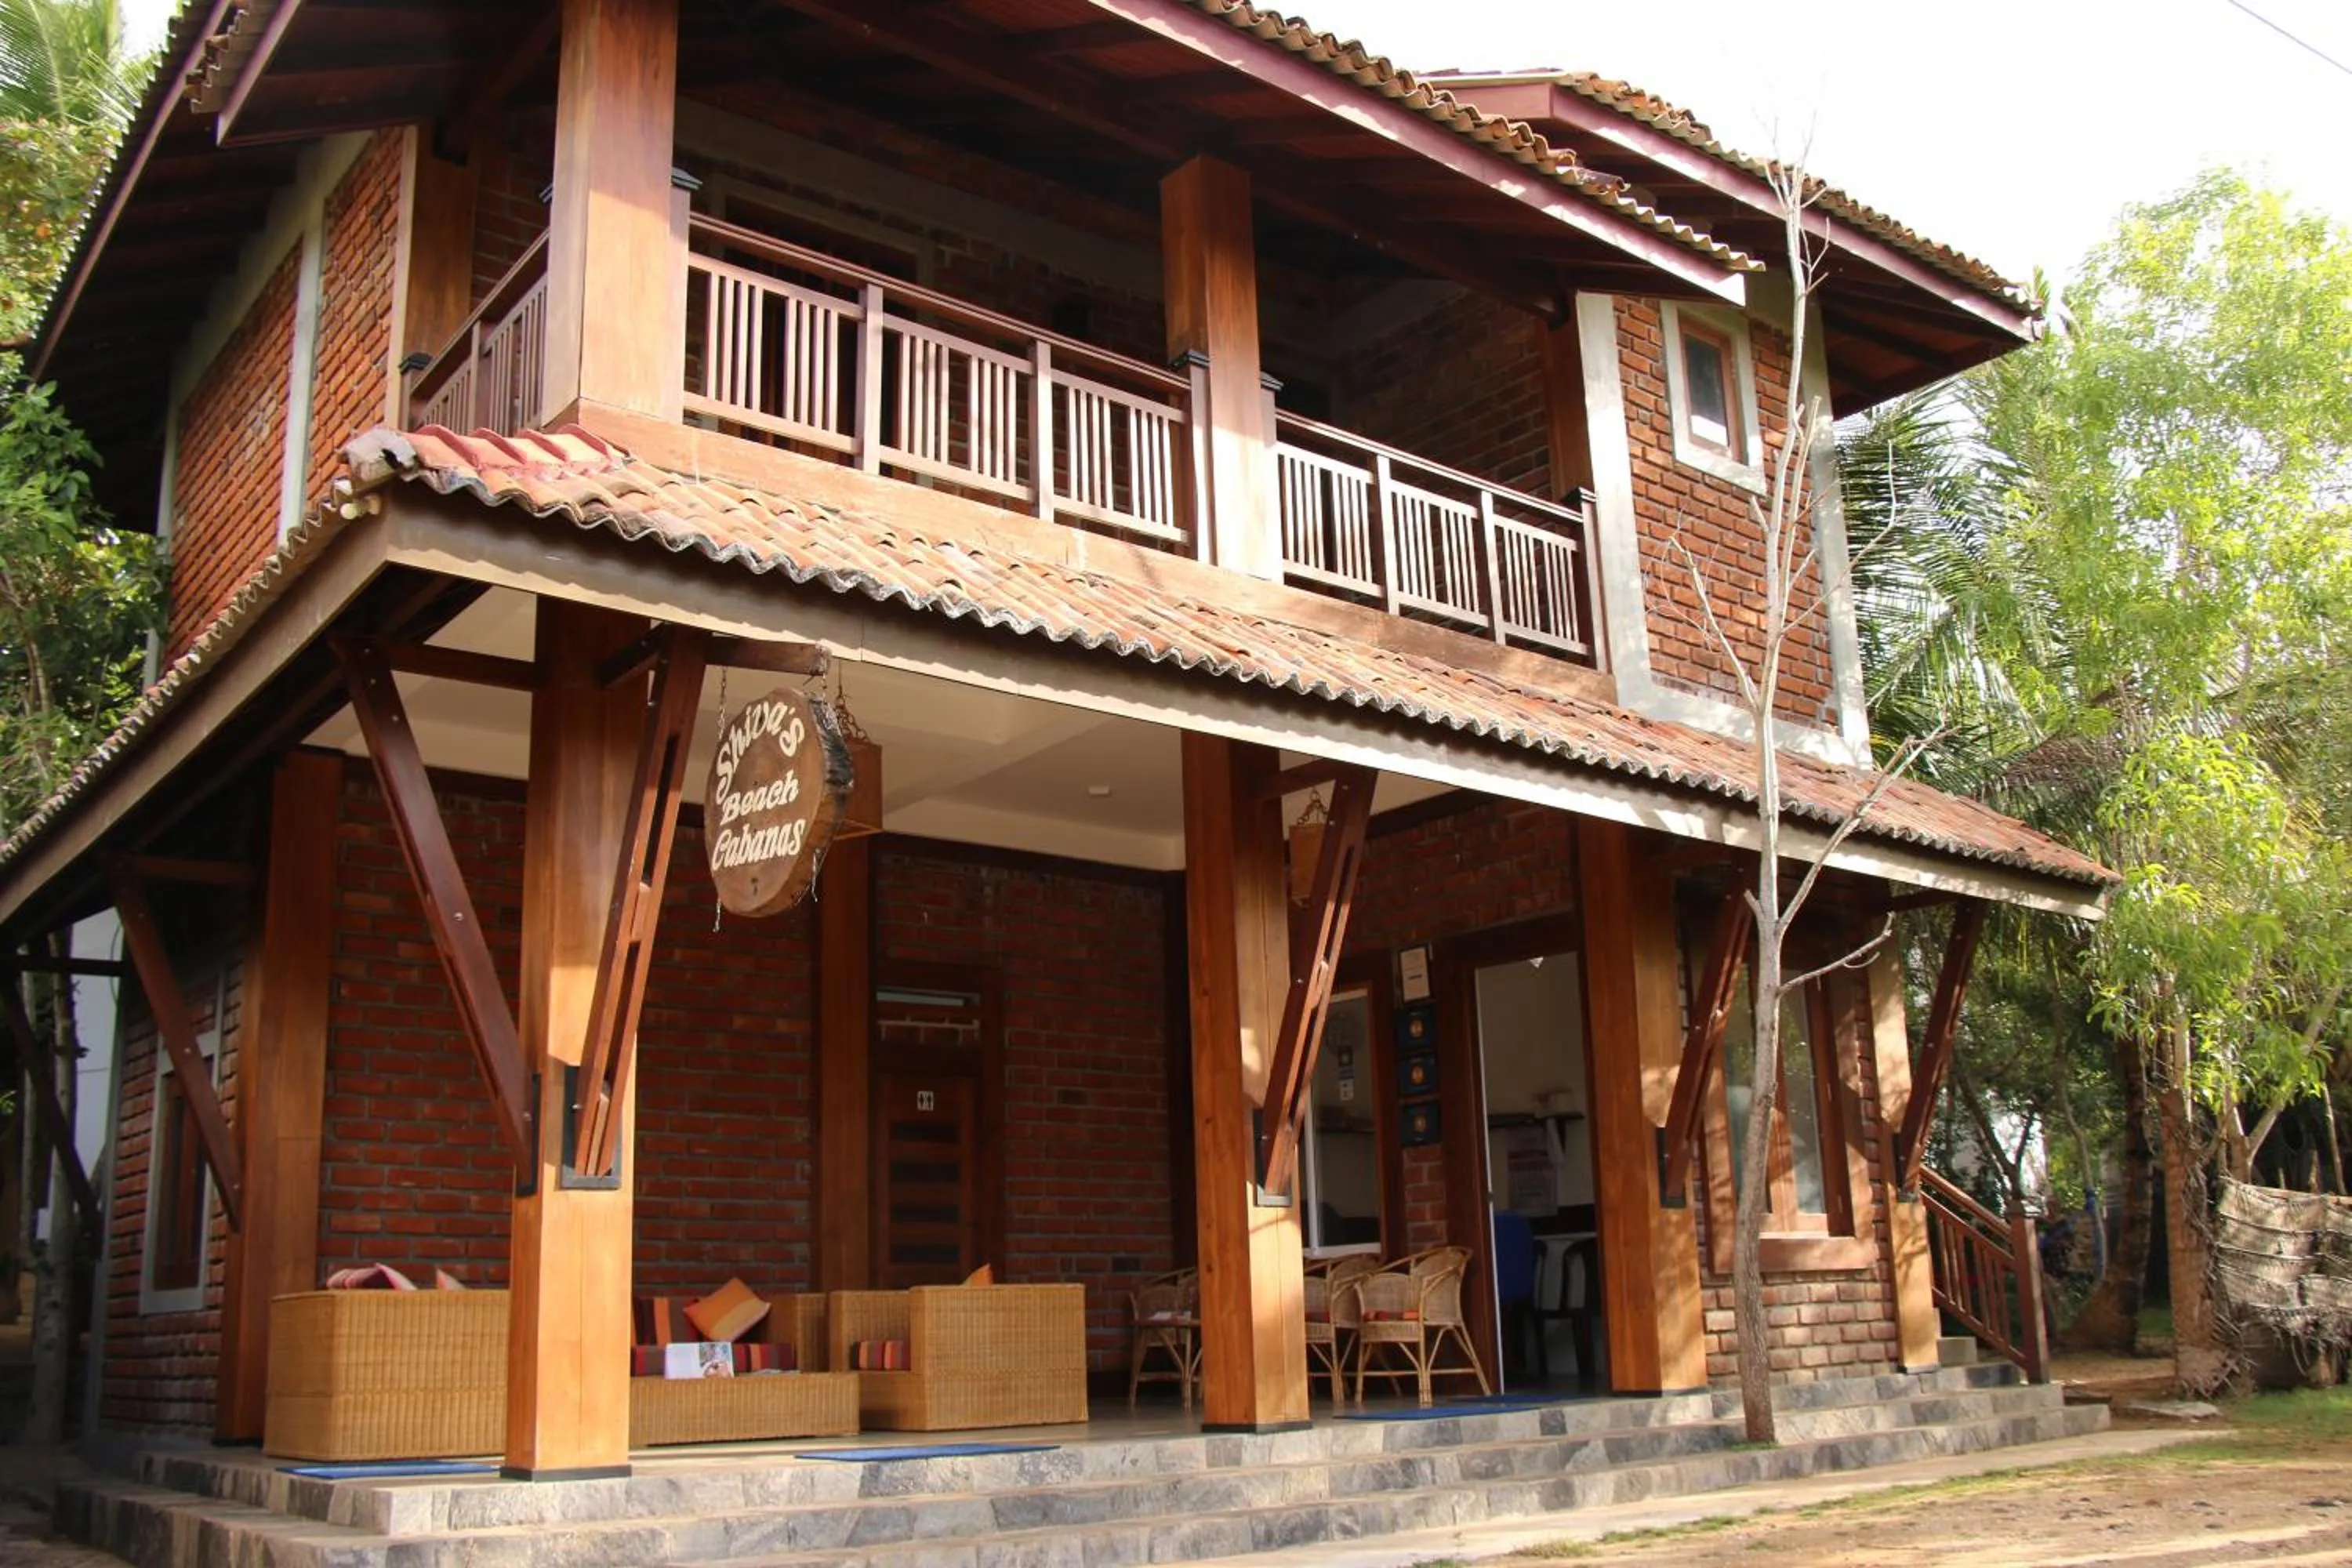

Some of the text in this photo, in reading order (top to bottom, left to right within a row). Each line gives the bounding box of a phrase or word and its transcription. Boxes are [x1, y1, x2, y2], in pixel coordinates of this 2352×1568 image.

[717, 701, 804, 804] Shiva's
[720, 770, 799, 825] Beach
[712, 819, 806, 870] Cabanas
